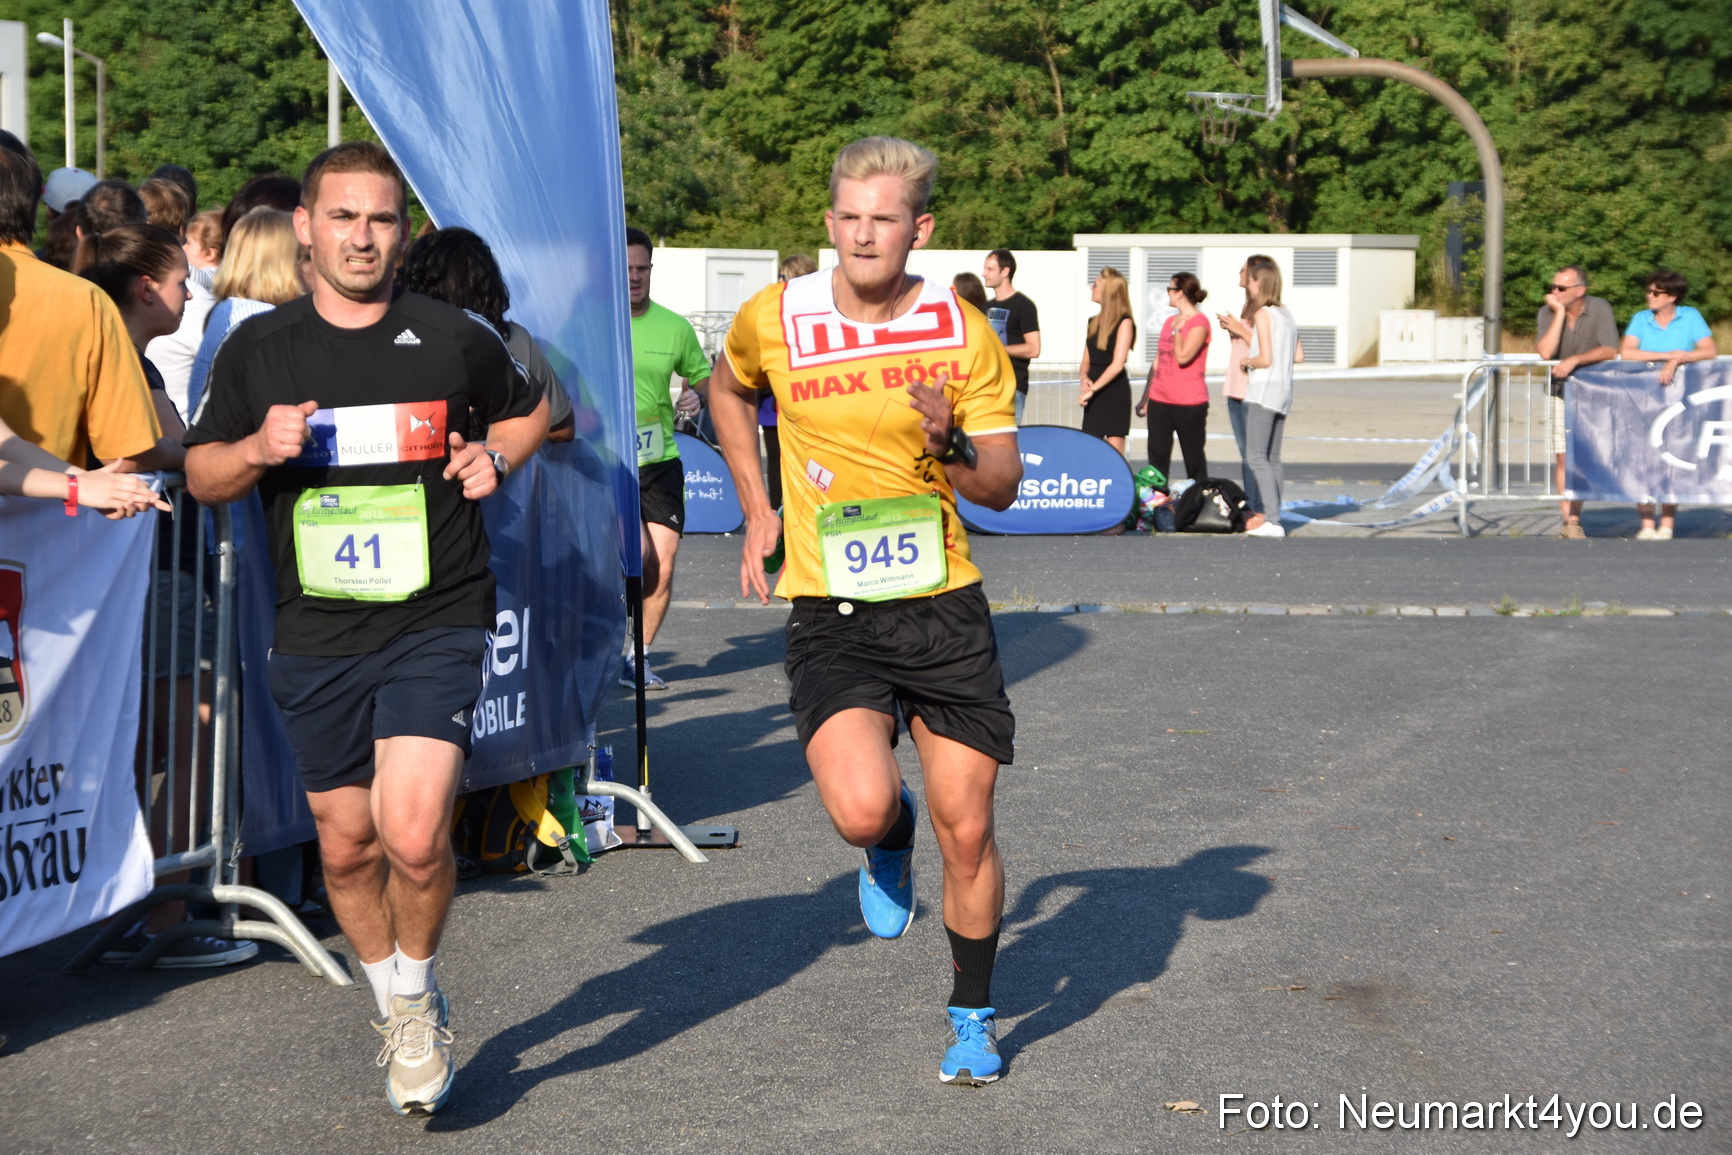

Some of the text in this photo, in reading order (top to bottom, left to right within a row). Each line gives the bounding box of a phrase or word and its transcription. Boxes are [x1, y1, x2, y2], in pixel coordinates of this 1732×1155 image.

[790, 358, 971, 403] MAX BÖGL
[302, 450, 335, 459] GEOT
[341, 440, 393, 456] MÜLLER
[1009, 498, 1105, 509] AUTOMOBILE
[836, 512, 879, 525] firmenlauf
[334, 533, 381, 569] 41
[845, 532, 919, 574] 945
[333, 577, 367, 585] Thorsten
[857, 573, 915, 588] Marco Wittmann
